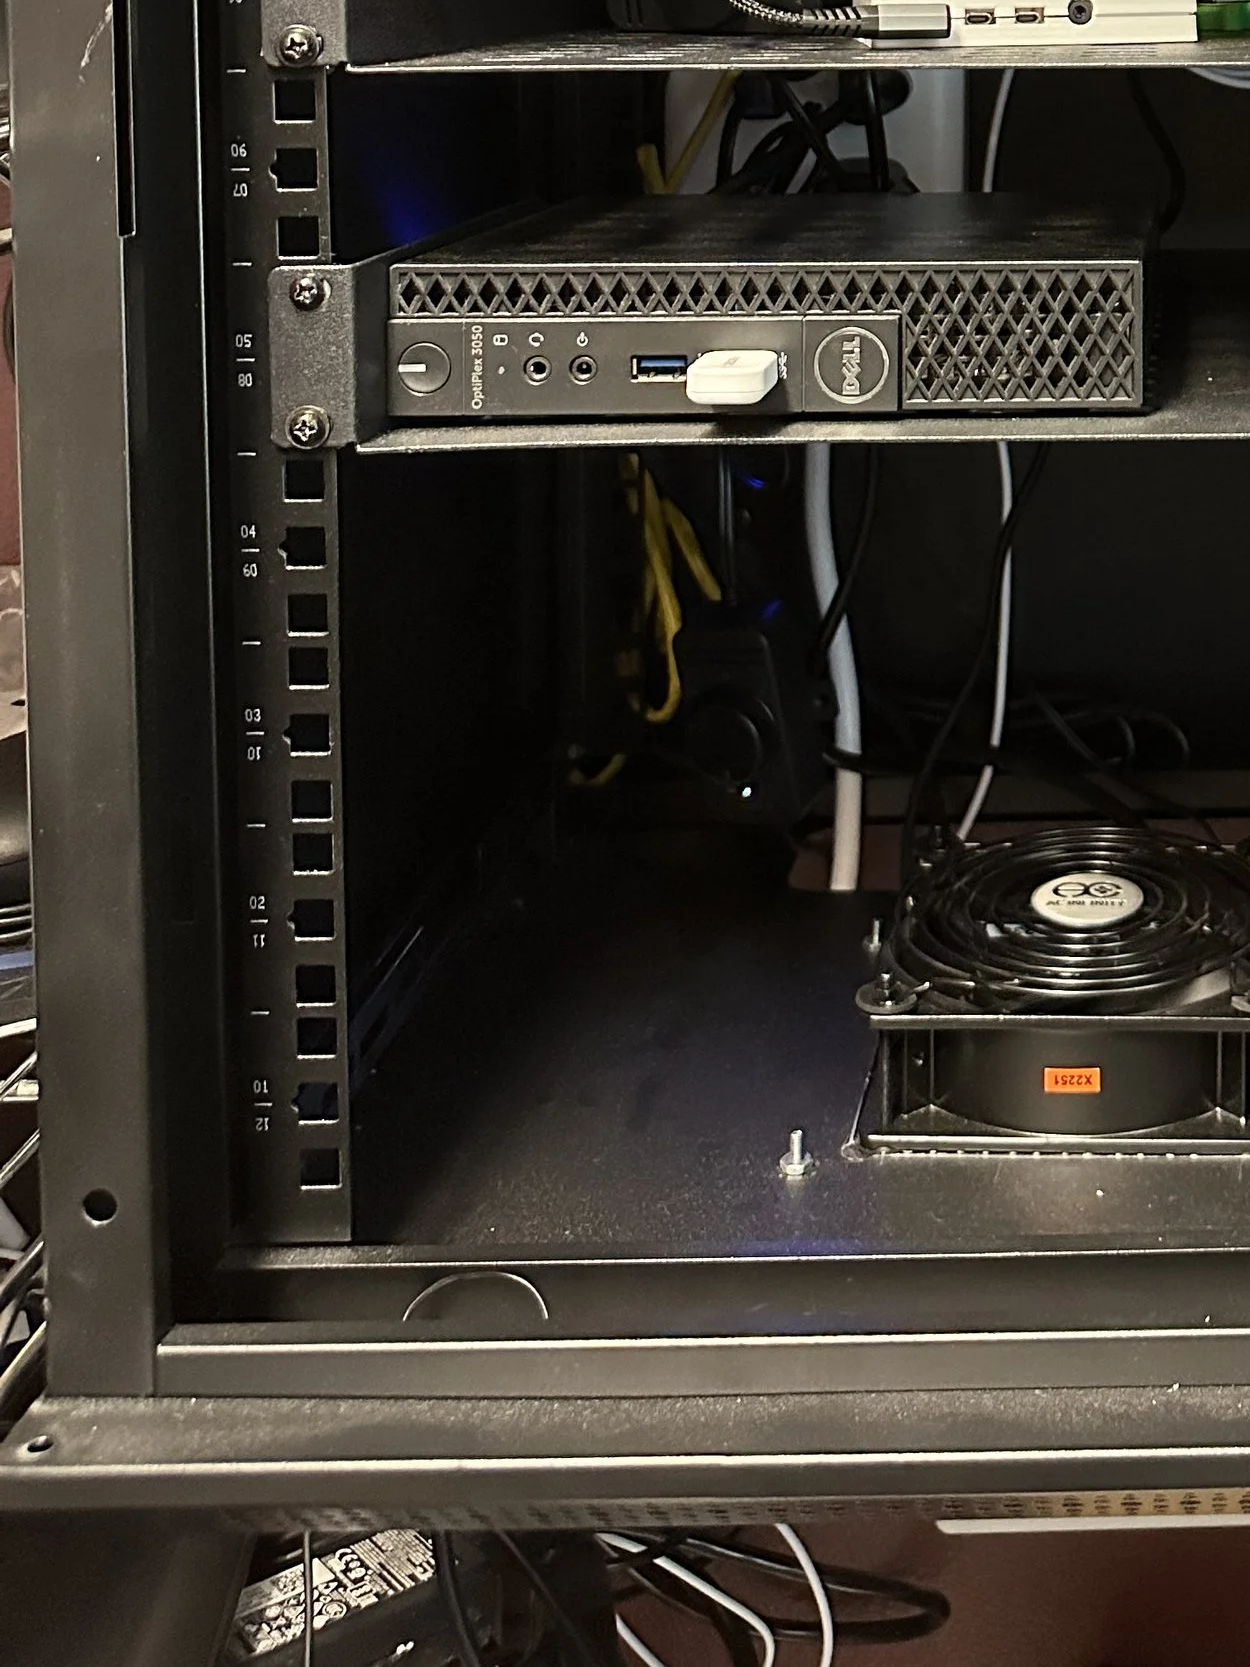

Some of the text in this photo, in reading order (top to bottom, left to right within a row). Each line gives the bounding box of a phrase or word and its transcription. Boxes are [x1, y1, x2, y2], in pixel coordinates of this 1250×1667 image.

[230, 143, 247, 158] 06
[235, 333, 253, 348] 05
[471, 324, 485, 410] OptiPlex 3050
[842, 336, 861, 396] DELL
[240, 524, 256, 539] 04
[245, 708, 261, 723] 03
[249, 895, 266, 910] 02
[256, 1080, 268, 1094] 01
[1054, 1074, 1093, 1086] X2251
